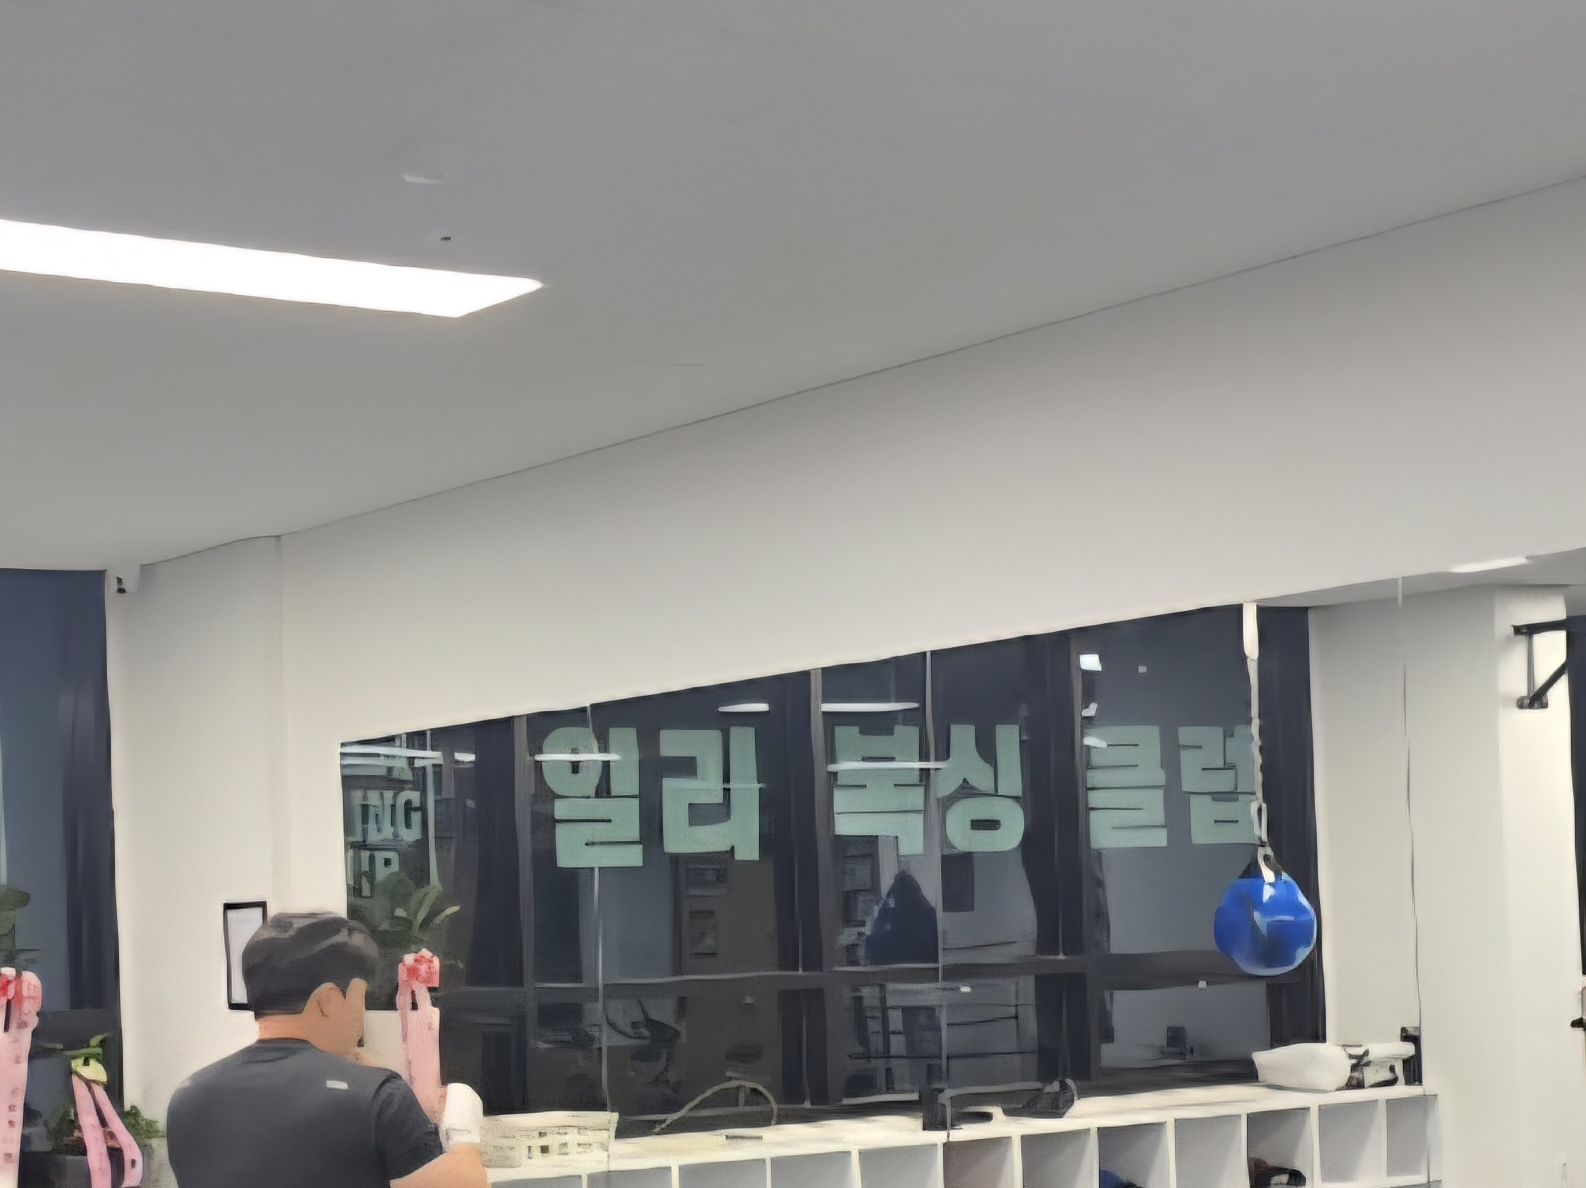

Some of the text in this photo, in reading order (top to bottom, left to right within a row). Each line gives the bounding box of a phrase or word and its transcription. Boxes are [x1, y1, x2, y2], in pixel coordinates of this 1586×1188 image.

[541, 723, 1261, 868] 일리 복싱 클럽
